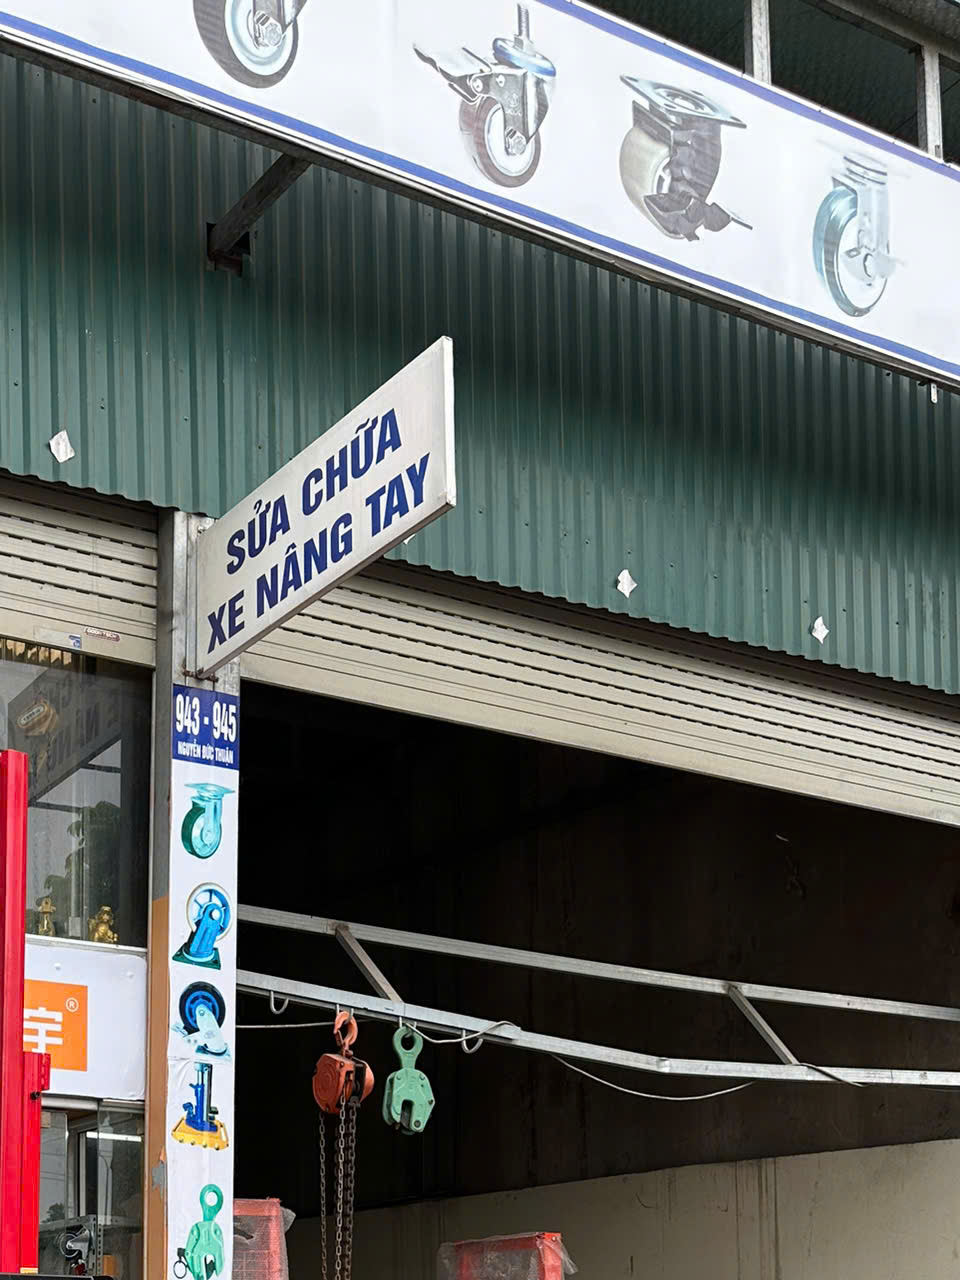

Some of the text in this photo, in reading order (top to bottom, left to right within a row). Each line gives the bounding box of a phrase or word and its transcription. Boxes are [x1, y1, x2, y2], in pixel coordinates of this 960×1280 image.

[207, 452, 430, 655] XE NÂNG TAY
[226, 408, 401, 575] SỬA CHỮA
[175, 693, 200, 735] 943
[212, 700, 237, 743] 945
